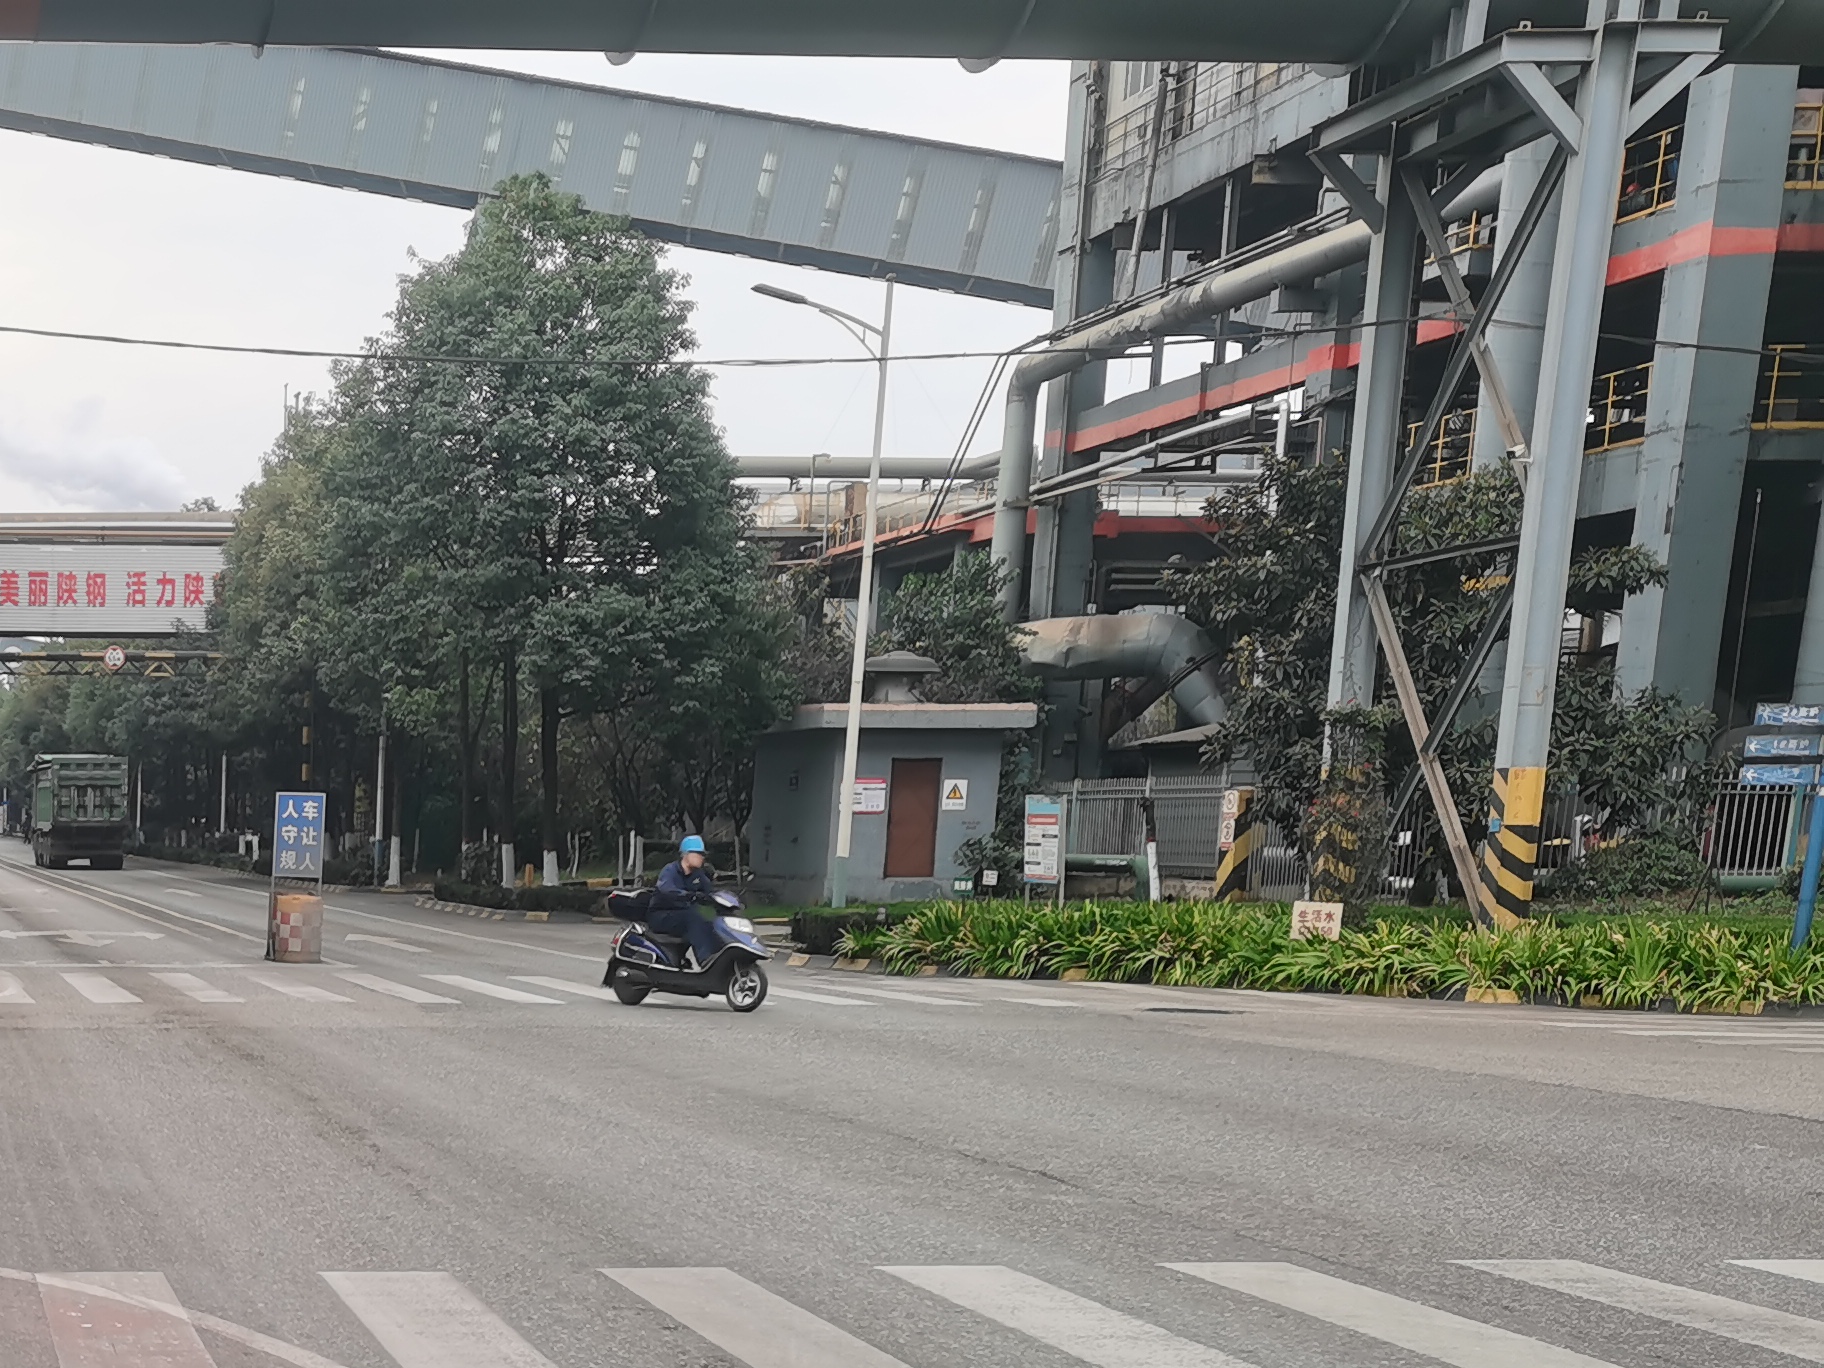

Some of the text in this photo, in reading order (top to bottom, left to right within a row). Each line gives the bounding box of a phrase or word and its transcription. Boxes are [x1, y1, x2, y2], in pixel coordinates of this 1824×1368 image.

[125, 571, 223, 607] 活力陕
[279, 798, 299, 870] 人守规
[299, 800, 319, 870] 车让人
